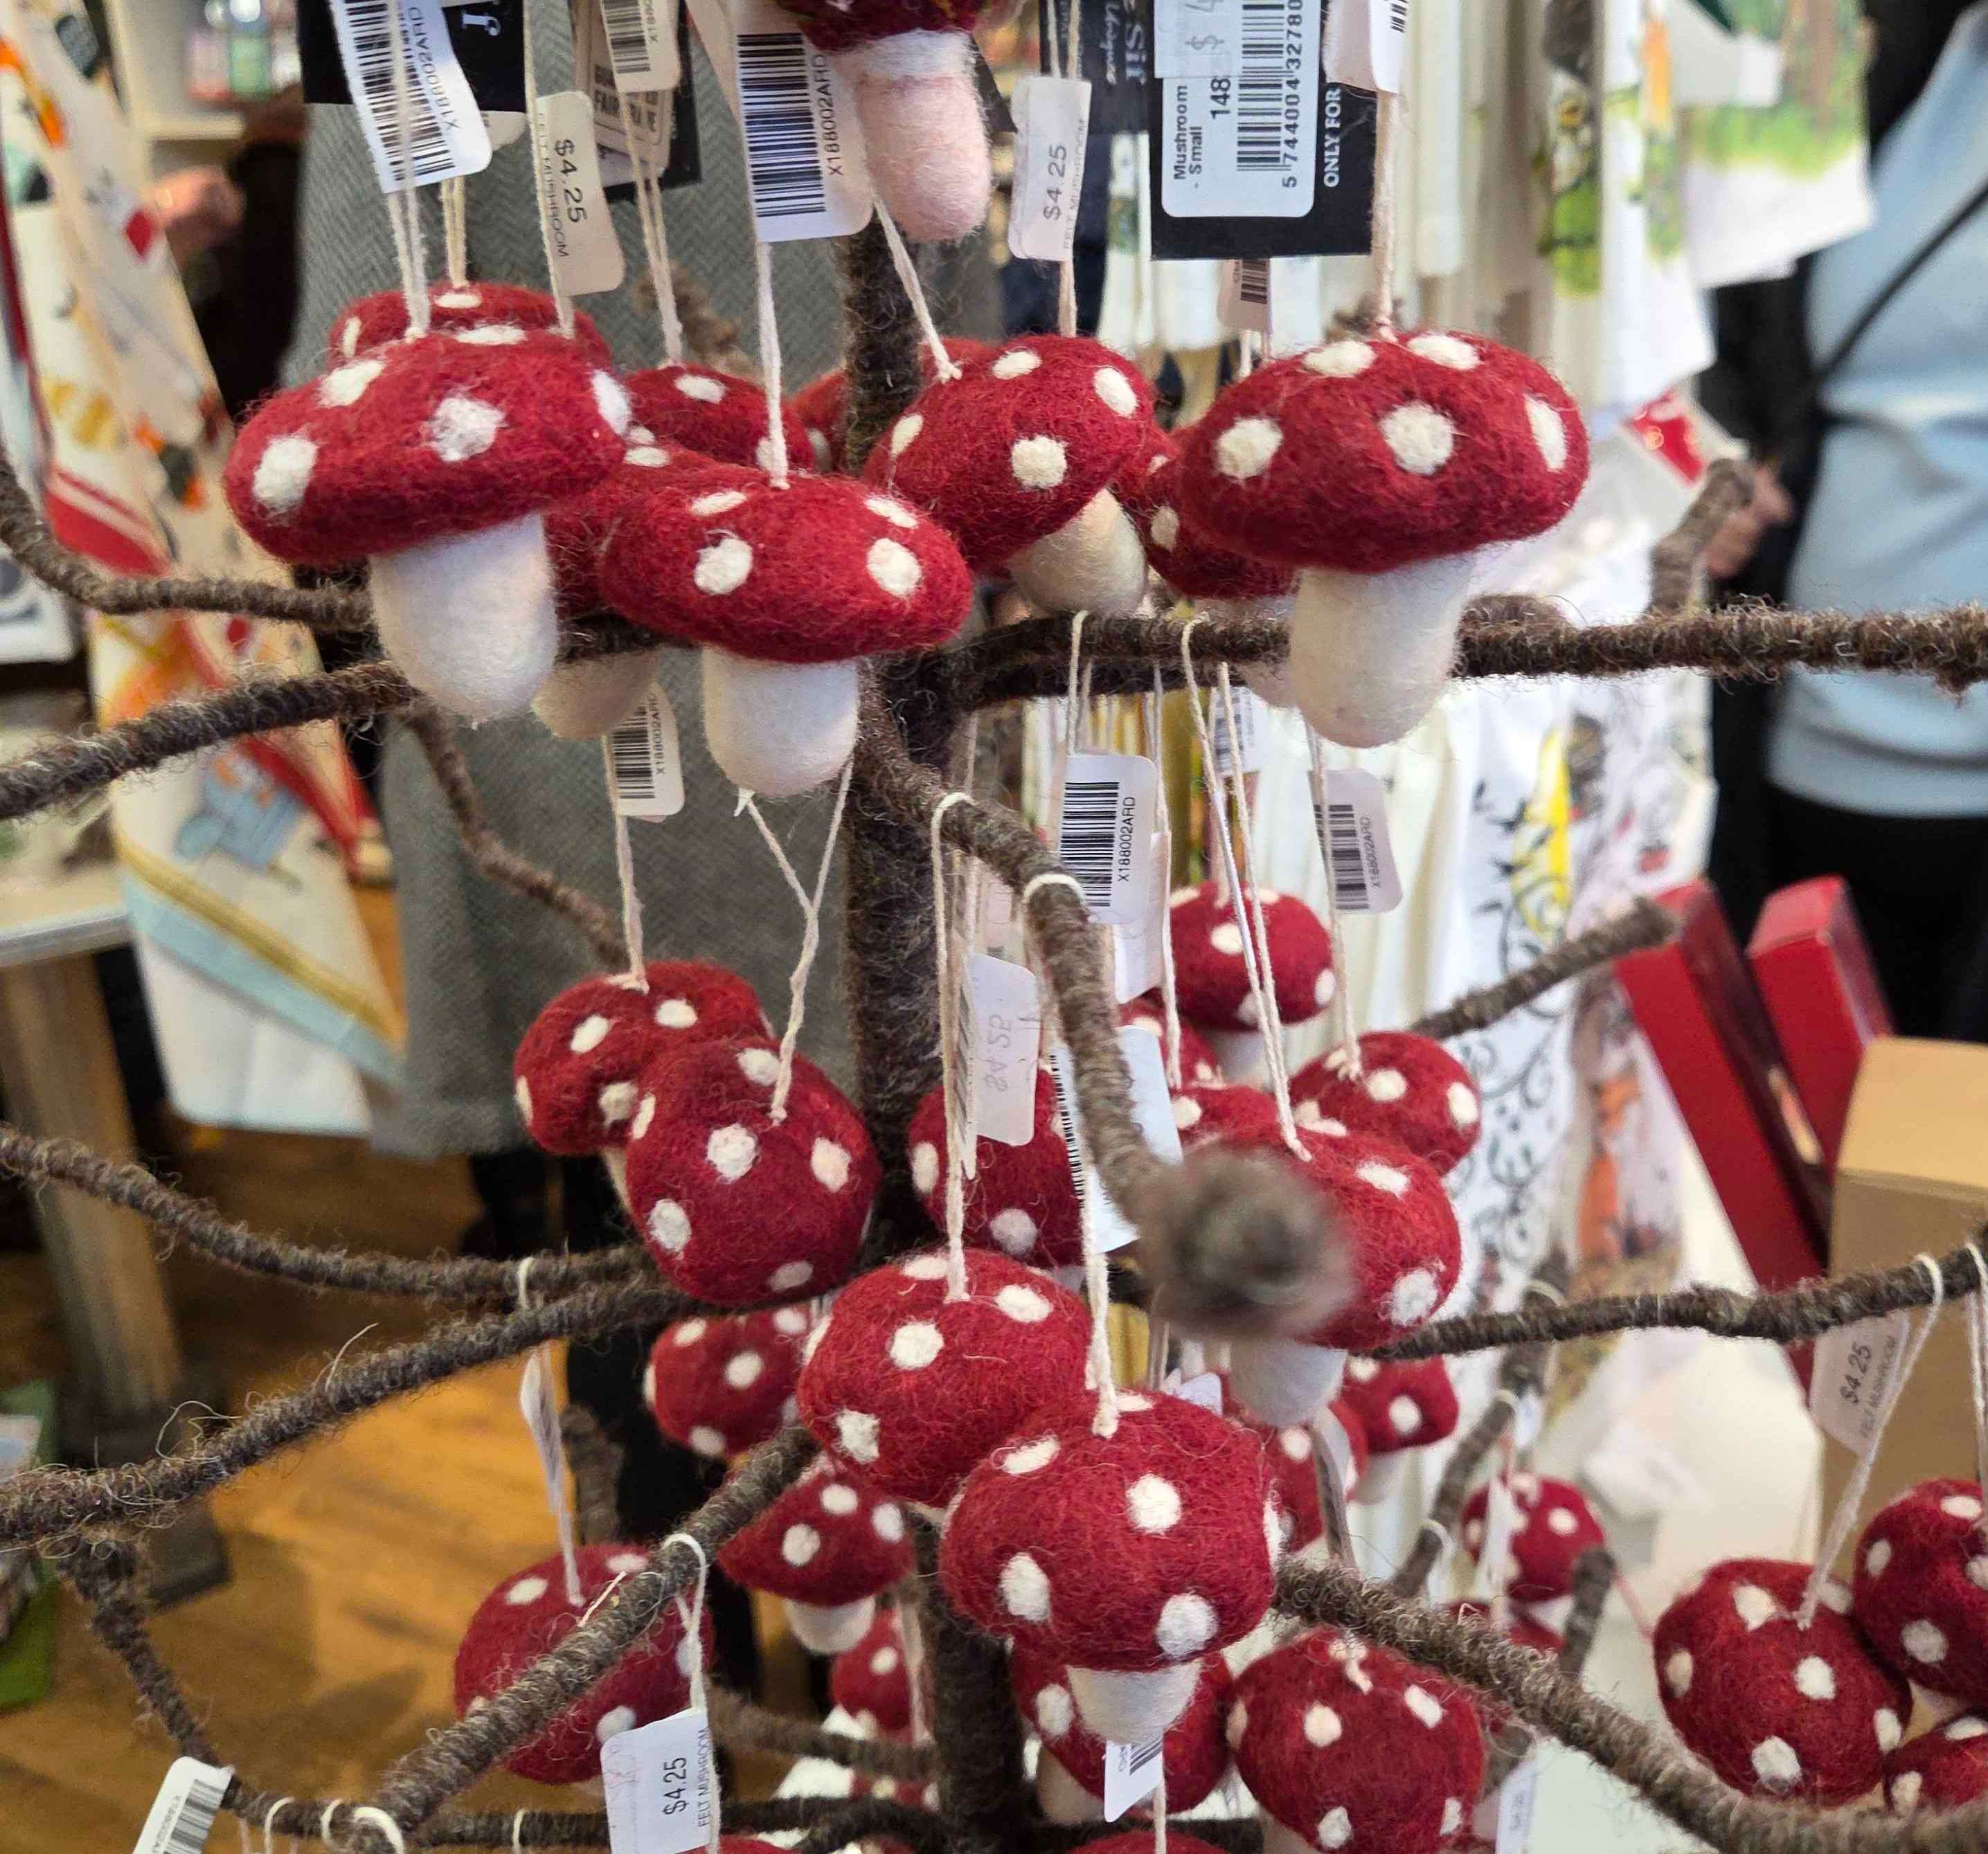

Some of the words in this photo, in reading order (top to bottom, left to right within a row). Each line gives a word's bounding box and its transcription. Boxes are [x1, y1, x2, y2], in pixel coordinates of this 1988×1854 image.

[1210, 78, 1230, 120] 148
[1325, 89, 1341, 128] FOR
[1173, 85, 1188, 180] Mushroom
[1188, 127, 1203, 175] Small
[1323, 133, 1341, 187] ONLY
[554, 138, 588, 223] $4.25
[1043, 144, 1067, 221] $4.25
[661, 1758, 690, 1815] $4.25
[697, 1727, 710, 1797] MUSHROOM
[697, 1801, 710, 1827] FELT
